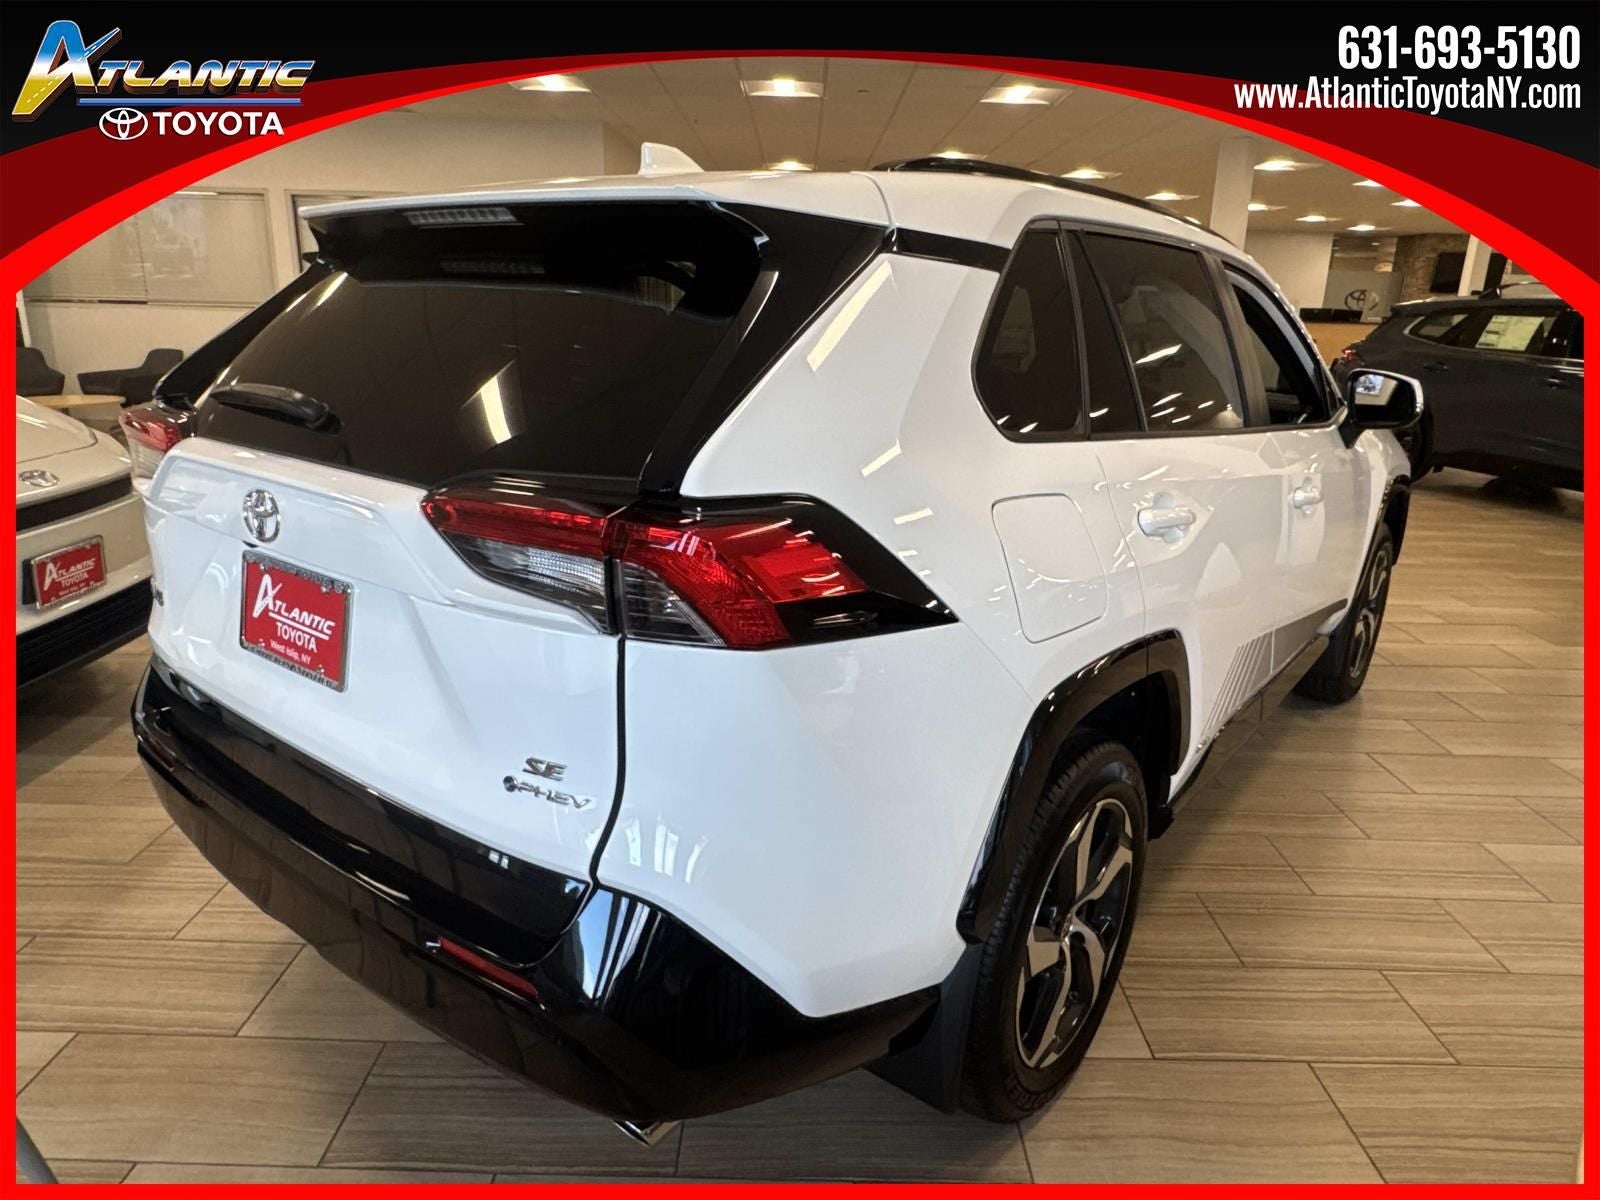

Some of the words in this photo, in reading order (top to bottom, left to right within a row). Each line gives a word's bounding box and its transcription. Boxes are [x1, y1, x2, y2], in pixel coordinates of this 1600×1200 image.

[61, 572, 88, 587] TOYOTA
[252, 574, 336, 635] ATLANTIC
[276, 622, 317, 652] TOYOTA
[270, 639, 286, 654] West
[301, 653, 312, 665] NY
[522, 757, 568, 781] SE
[517, 781, 592, 809] PHEV
